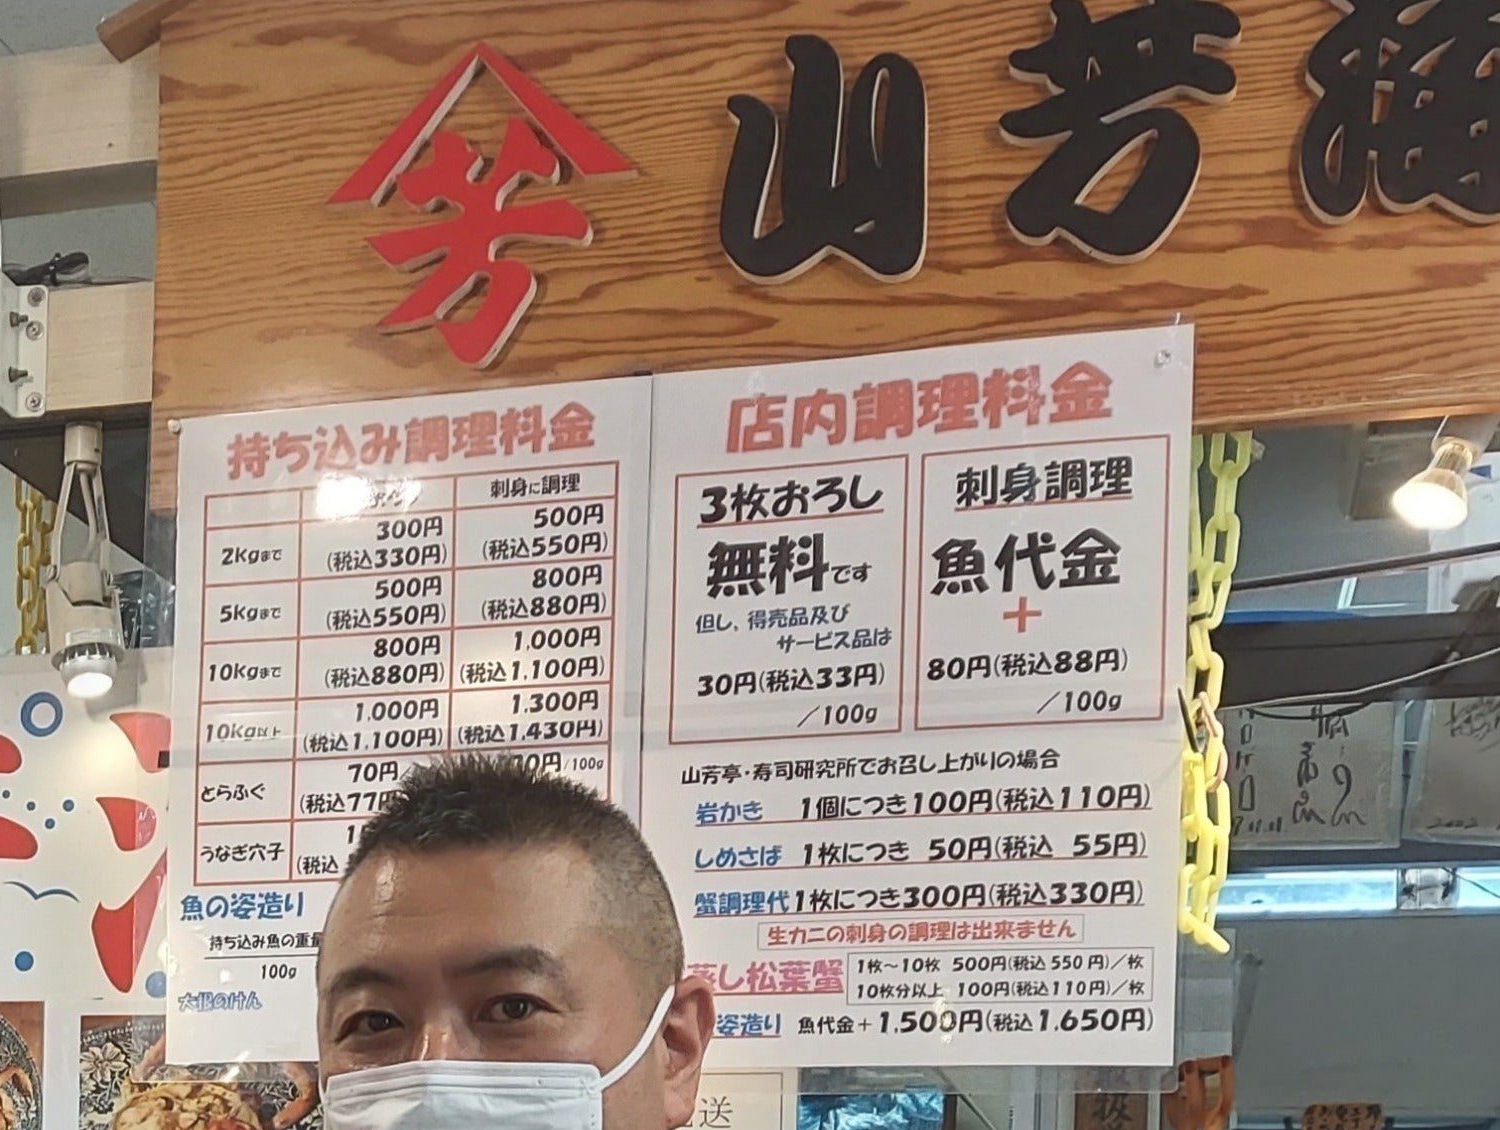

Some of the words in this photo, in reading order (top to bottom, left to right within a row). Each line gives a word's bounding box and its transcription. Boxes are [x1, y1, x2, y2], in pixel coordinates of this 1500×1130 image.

[726, 360, 1113, 454] 店内調理料金
[227, 401, 596, 480] 持ち込み調理料金
[490, 473, 580, 498] 刺身に調理
[955, 456, 1134, 508] 刺身調理
[700, 474, 884, 524] 3枚おろし
[376, 516, 444, 541] 300円
[533, 503, 604, 529] 500円
[327, 543, 448, 572] (税込330円)
[482, 531, 608, 561] (税込550円)
[707, 532, 873, 599] 無料です
[930, 527, 1122, 596] 魚代金
[375, 575, 442, 600] 500円
[532, 564, 602, 588] 800円
[326, 602, 447, 630] (税込550円)
[481, 592, 607, 621] (税込880円)
[374, 634, 441, 658] 800円
[776, 627, 893, 654] サービス品は
[324, 662, 445, 689] (税込880円)
[927, 648, 1129, 681] 80円(税込88円)
[697, 662, 885, 697] 30円(税込33円)
[201, 783, 266, 803] とらふぐ
[696, 801, 763, 824] 岩かき
[201, 843, 285, 863] うなぎ穴子
[695, 845, 782, 869] しめさば
[180, 892, 304, 921] 魚の姿造り
[767, 920, 1077, 946] 生カニの刺身の調理は出来ません
[261, 963, 297, 980] 100g
[712, 1013, 781, 1035] 姿造り
